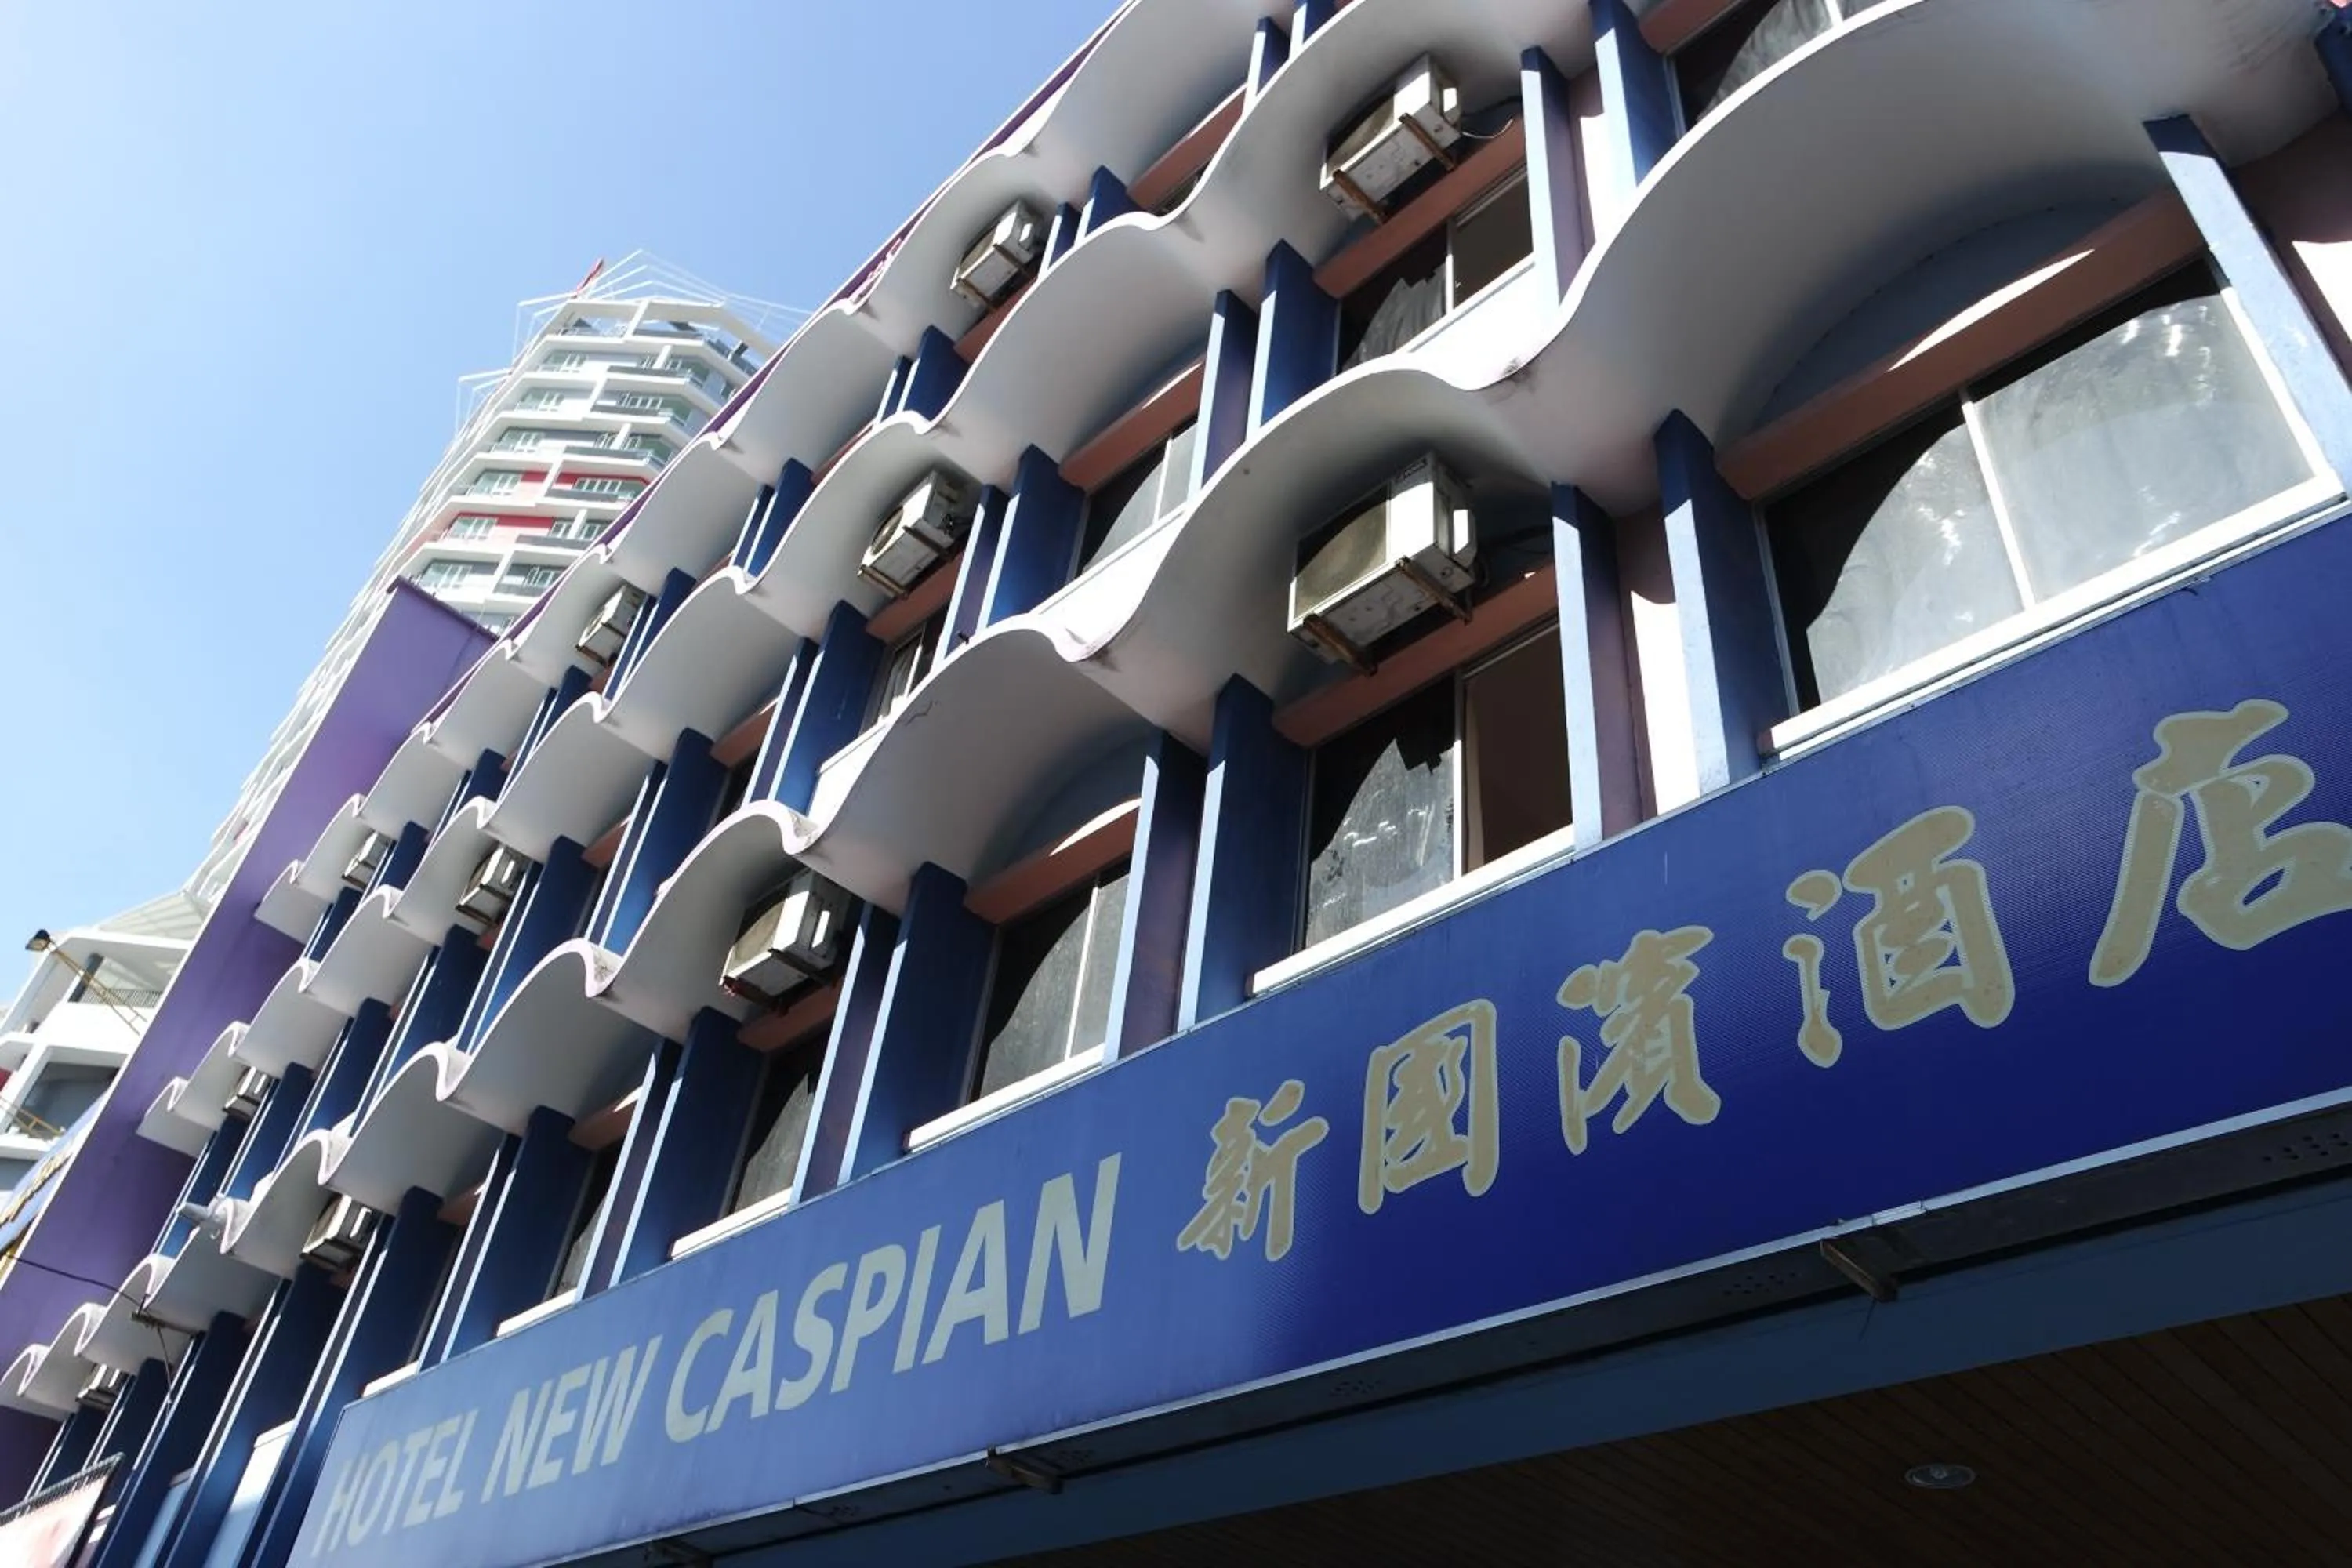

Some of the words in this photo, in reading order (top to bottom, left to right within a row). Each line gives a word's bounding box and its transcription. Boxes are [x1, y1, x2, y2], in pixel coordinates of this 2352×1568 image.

[310, 1409, 478, 1558] HOTEL
[480, 1334, 663, 1504] NEW
[665, 1153, 1121, 1443] CASPIAN
